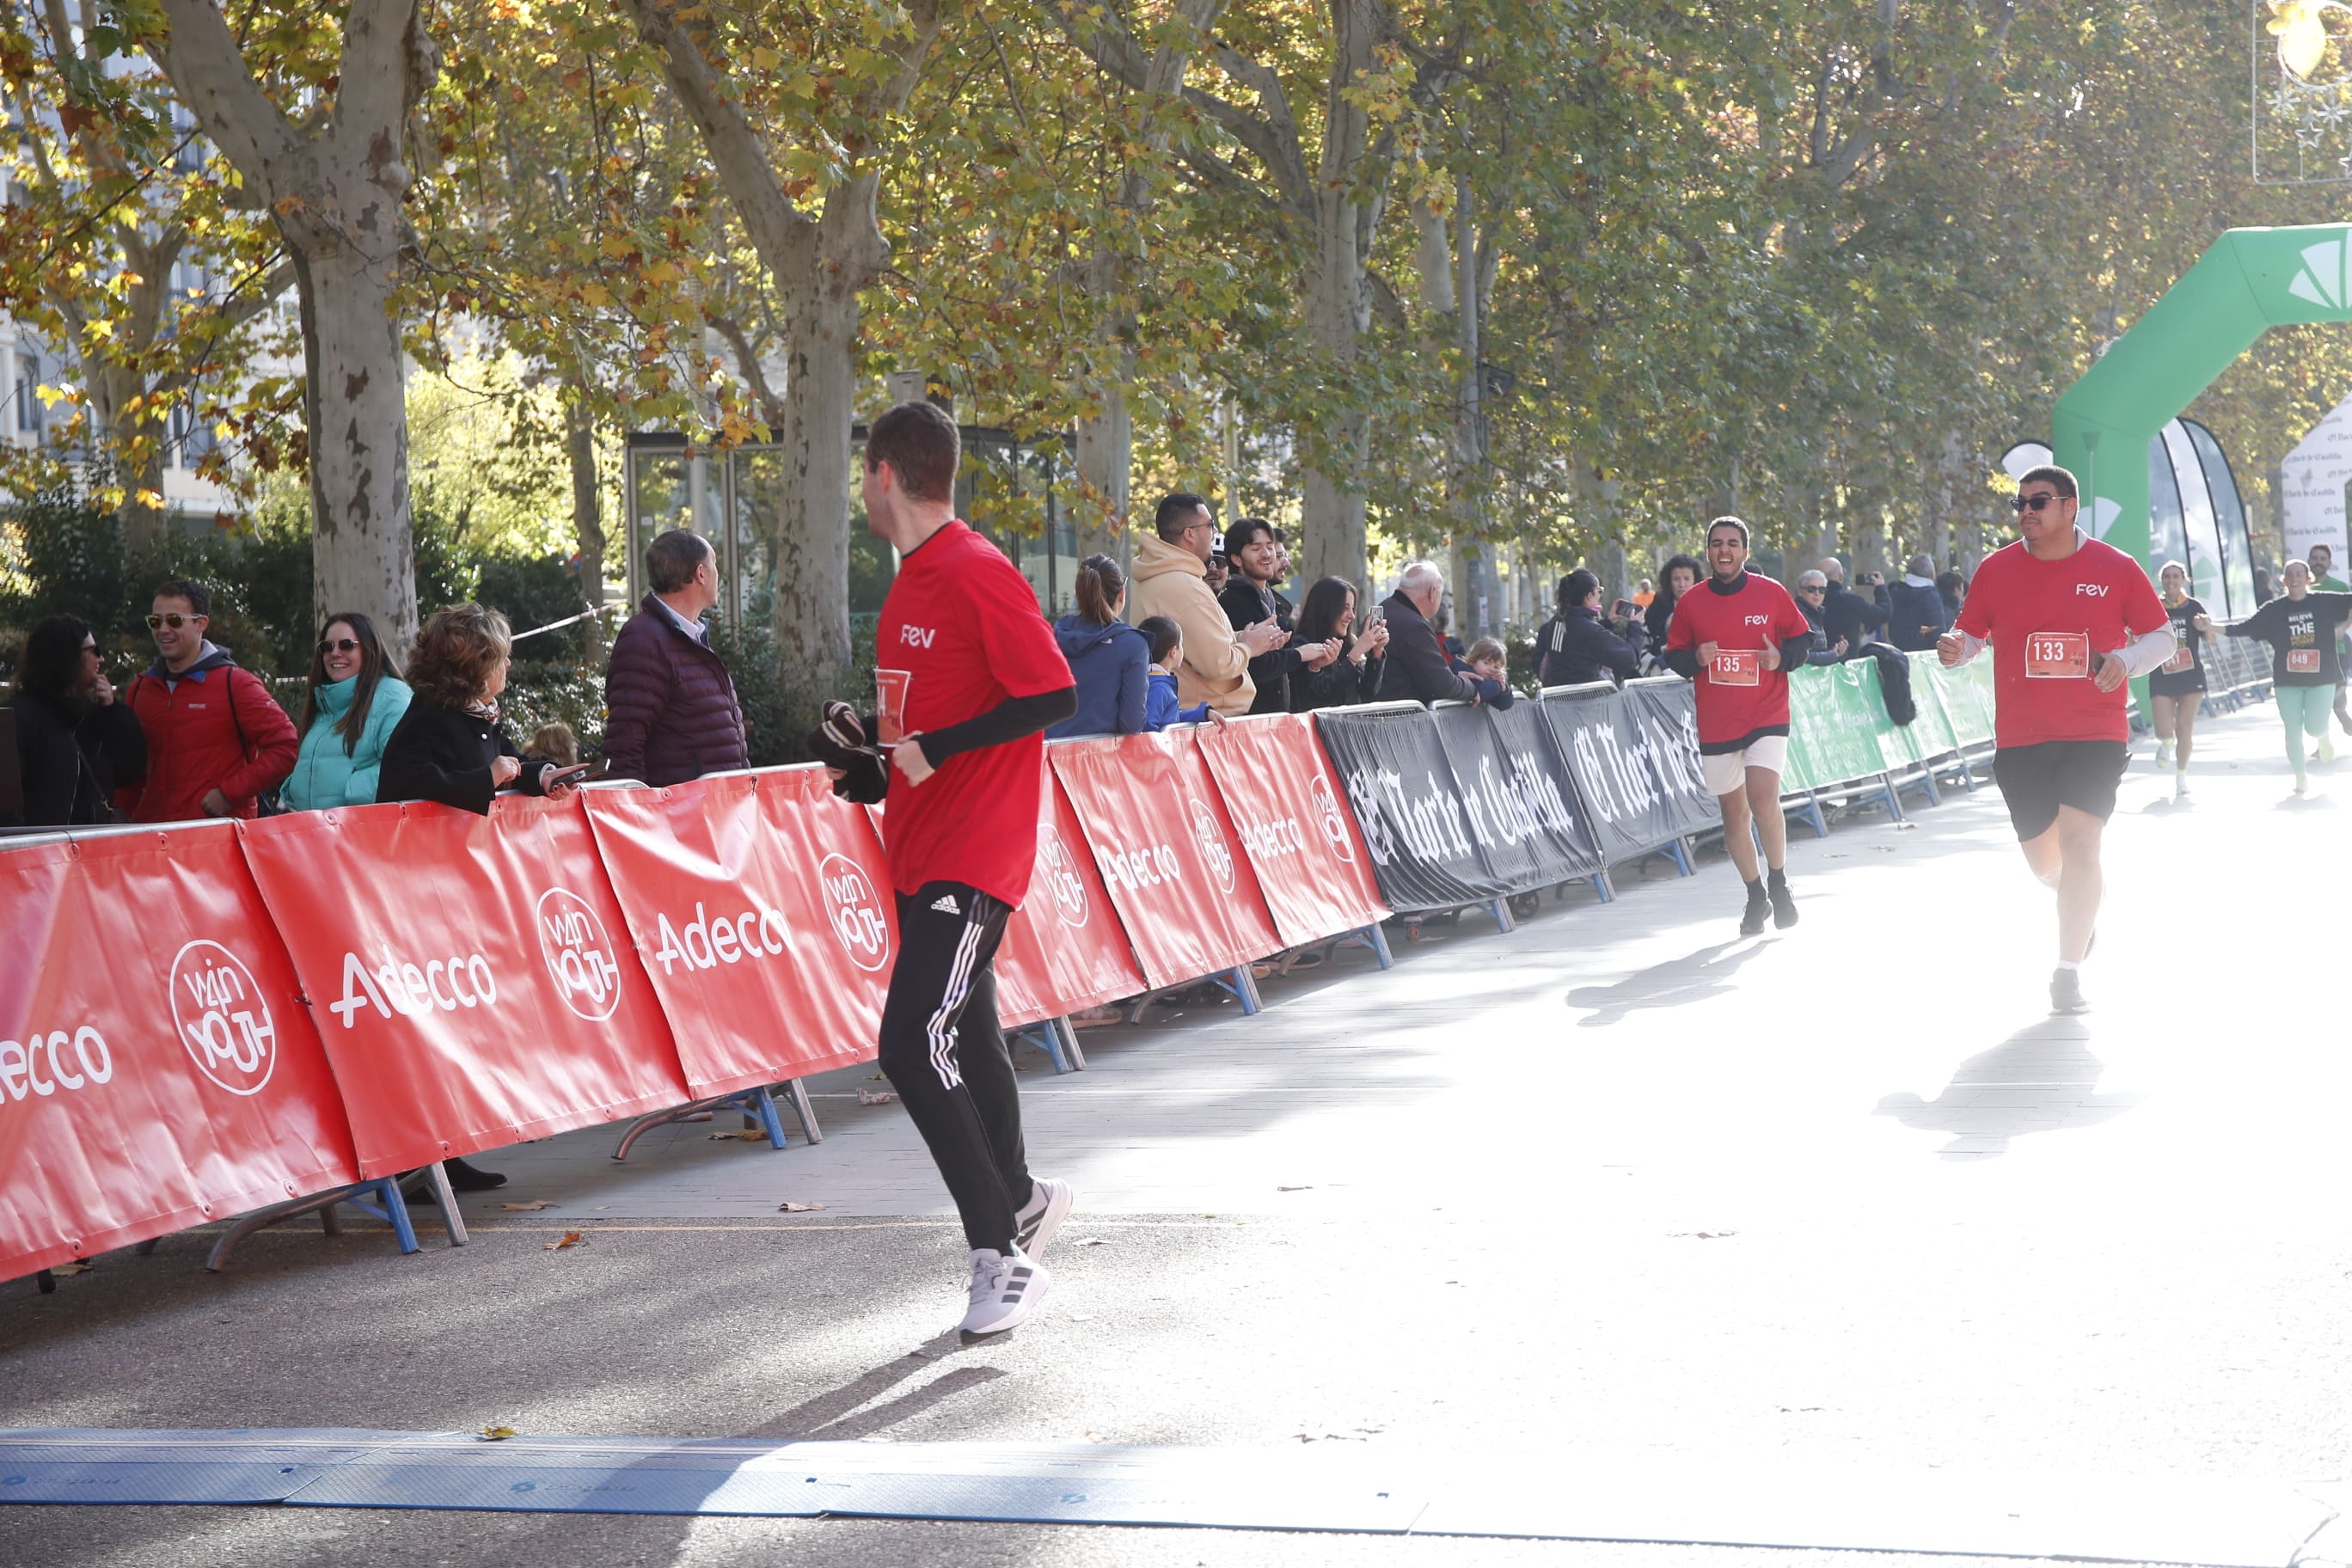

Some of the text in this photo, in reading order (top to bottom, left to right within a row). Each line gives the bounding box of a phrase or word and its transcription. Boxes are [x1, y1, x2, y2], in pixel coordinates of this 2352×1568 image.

[2034, 641, 2064, 661] 133
[2289, 622, 2315, 636] THE
[1716, 656, 1740, 673] 135
[1244, 811, 1305, 859] Adecco
[1099, 838, 1181, 893] Adecco
[834, 905, 886, 955] YOUTH
[930, 903, 961, 916] adidas
[329, 943, 497, 1029] Adecco
[550, 947, 619, 1004] YOUTH
[186, 1006, 276, 1074] YOUTH
[0, 1025, 113, 1106] ecco
